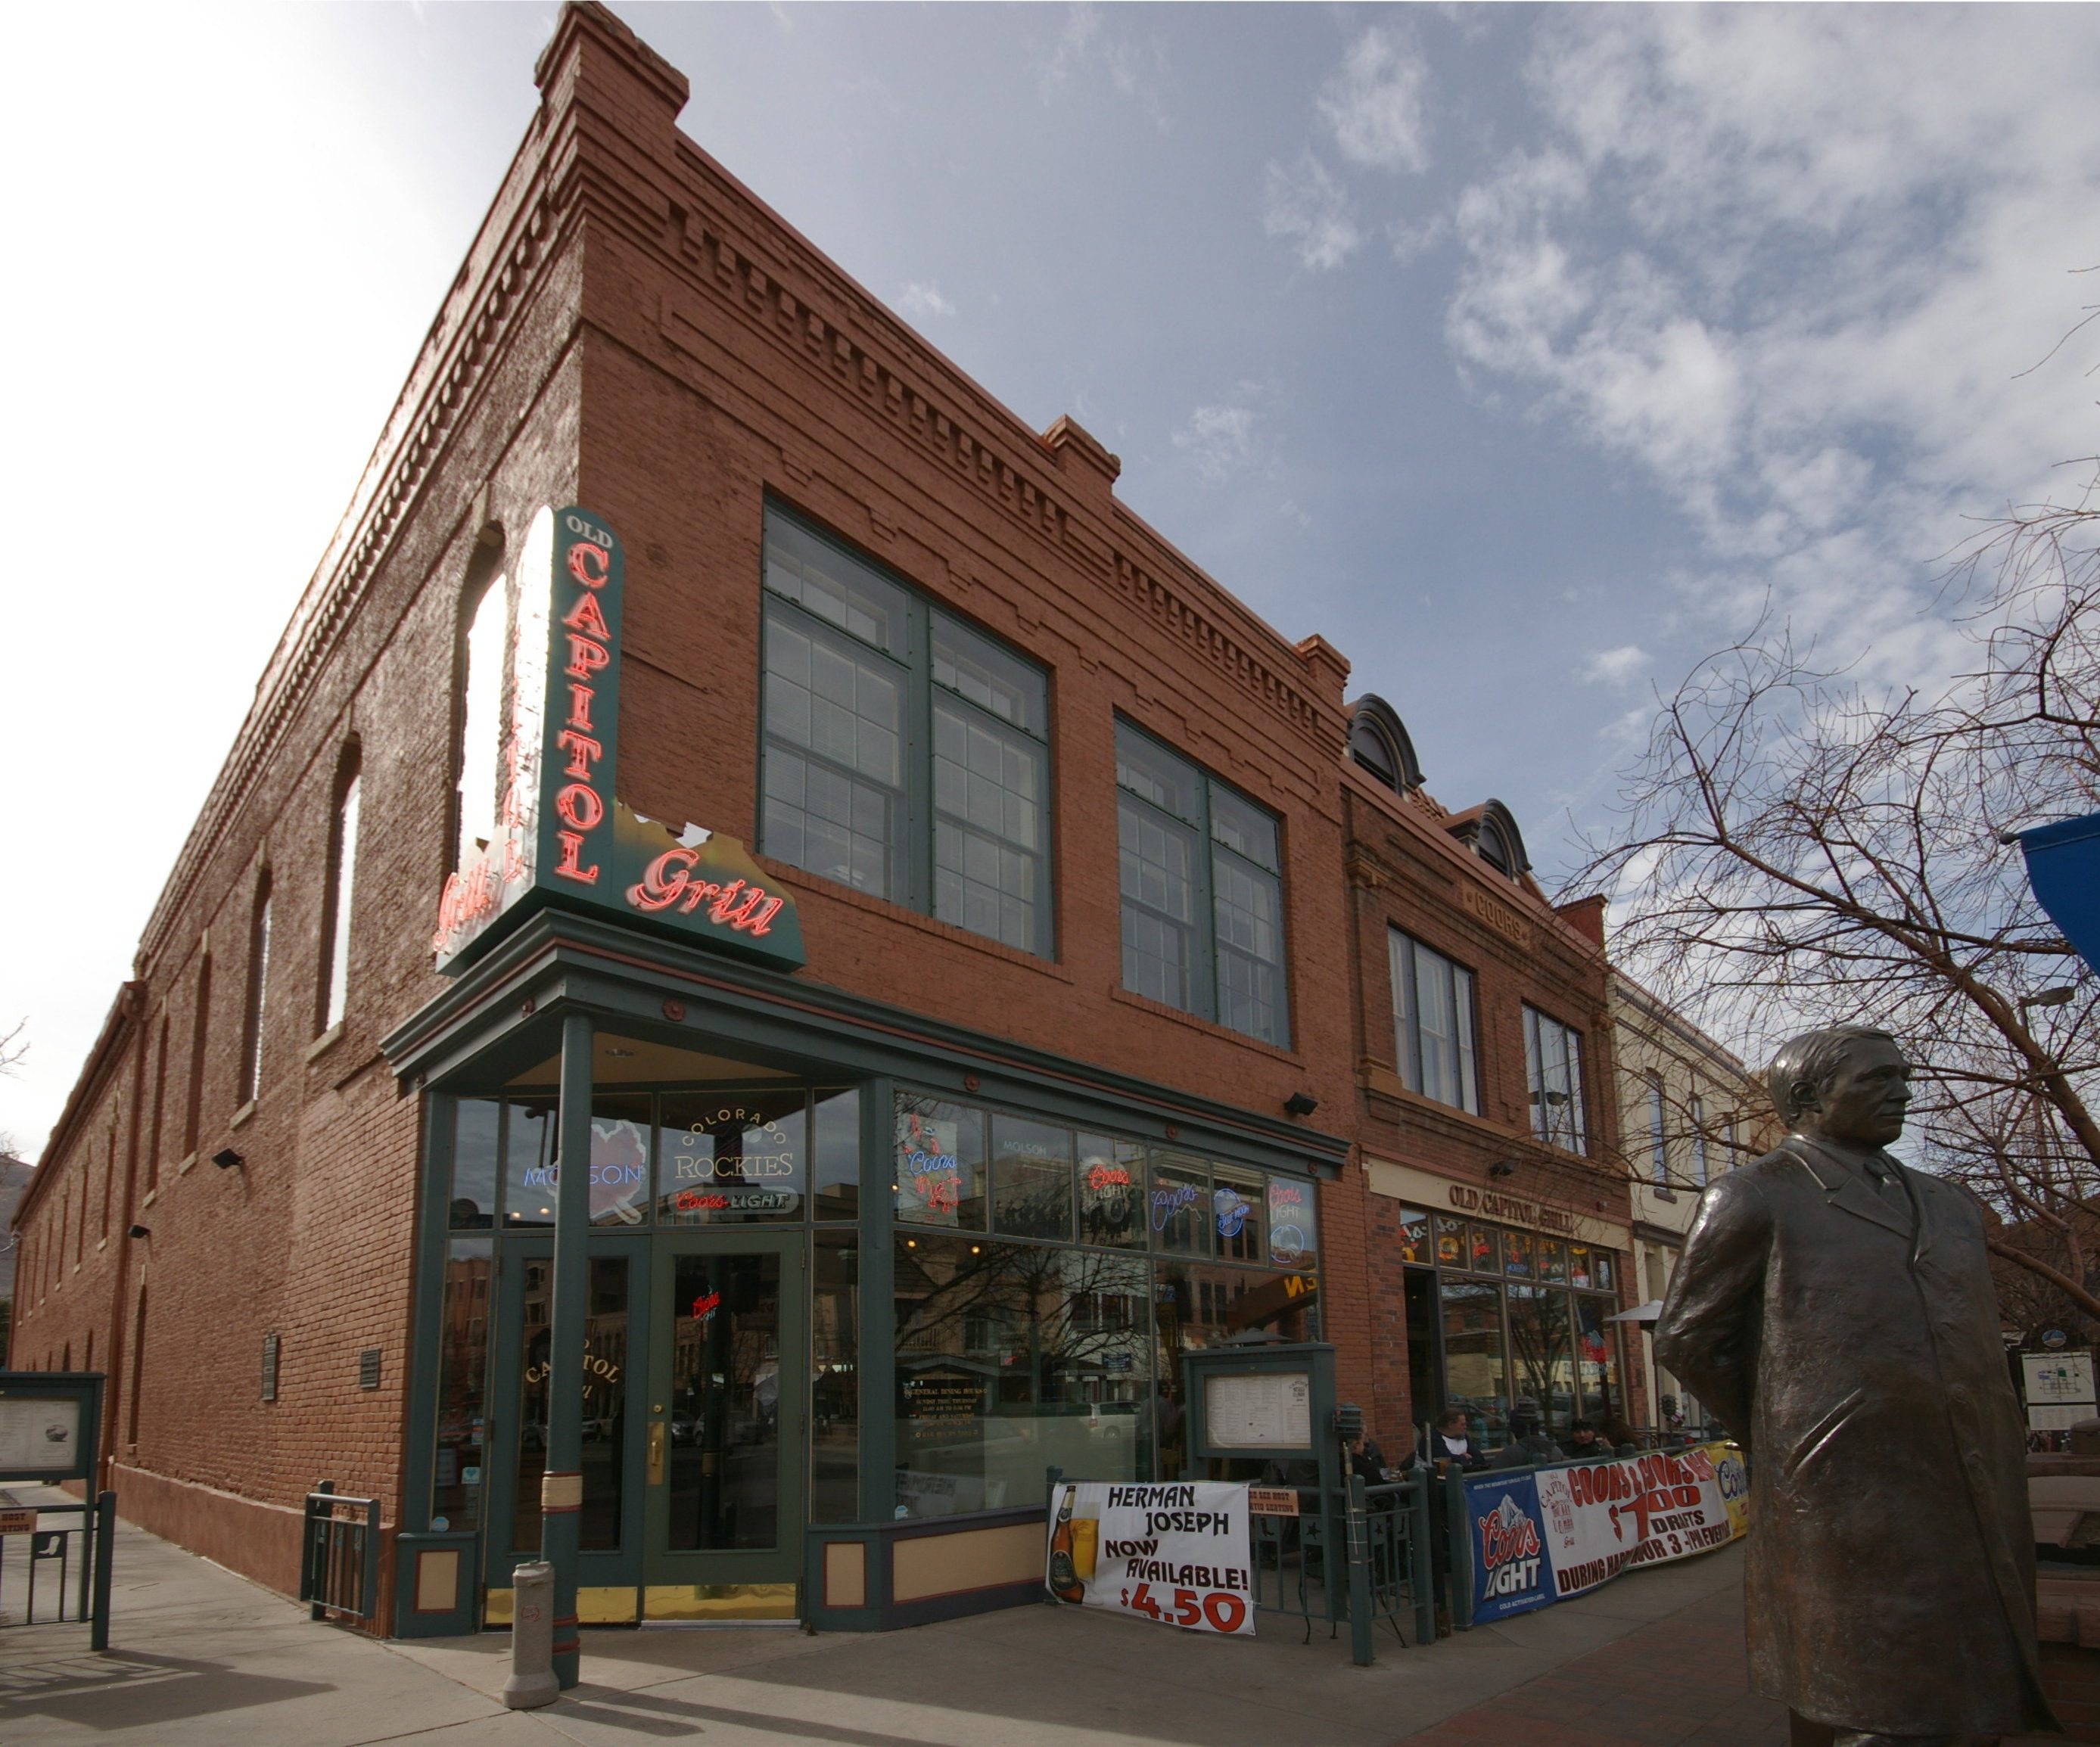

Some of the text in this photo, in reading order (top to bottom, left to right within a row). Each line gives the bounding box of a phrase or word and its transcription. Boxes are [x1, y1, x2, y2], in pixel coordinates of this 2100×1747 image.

[566, 514, 613, 549] OLD
[553, 541, 612, 884] CAPITOL
[627, 846, 784, 937] Grill
[1476, 893, 1523, 941] COORS
[682, 1108, 786, 1147] COLORADO
[909, 1150, 957, 1174] Coors
[1003, 1140, 1047, 1155] MOLSON
[523, 1164, 644, 1188] MOSON
[674, 1152, 793, 1179] ROCKIES
[1087, 1164, 1131, 1189] Coors
[675, 1190, 791, 1211] Coors LIGHT
[1269, 1184, 1302, 1208] Coors
[1449, 1185, 1572, 1233] OLD CAPITOL GRILL
[524, 1354, 621, 1385] CATOL
[1108, 1484, 1196, 1509] HERMAN
[1567, 1462, 1632, 1507] COORS
[1145, 1512, 1230, 1537] JOSEPH
[1649, 1510, 1706, 1534] DRAFTS
[1105, 1539, 1159, 1559] NOW
[1478, 1509, 1541, 1571] Coors
[1126, 1558, 1249, 1591] AVAILABLE!
[1482, 1558, 1541, 1600] LIGHT
[1557, 1558, 1605, 1593] DURING
[1667, 1533, 1683, 1555] 3
[1120, 1583, 1246, 1632] $4.50
